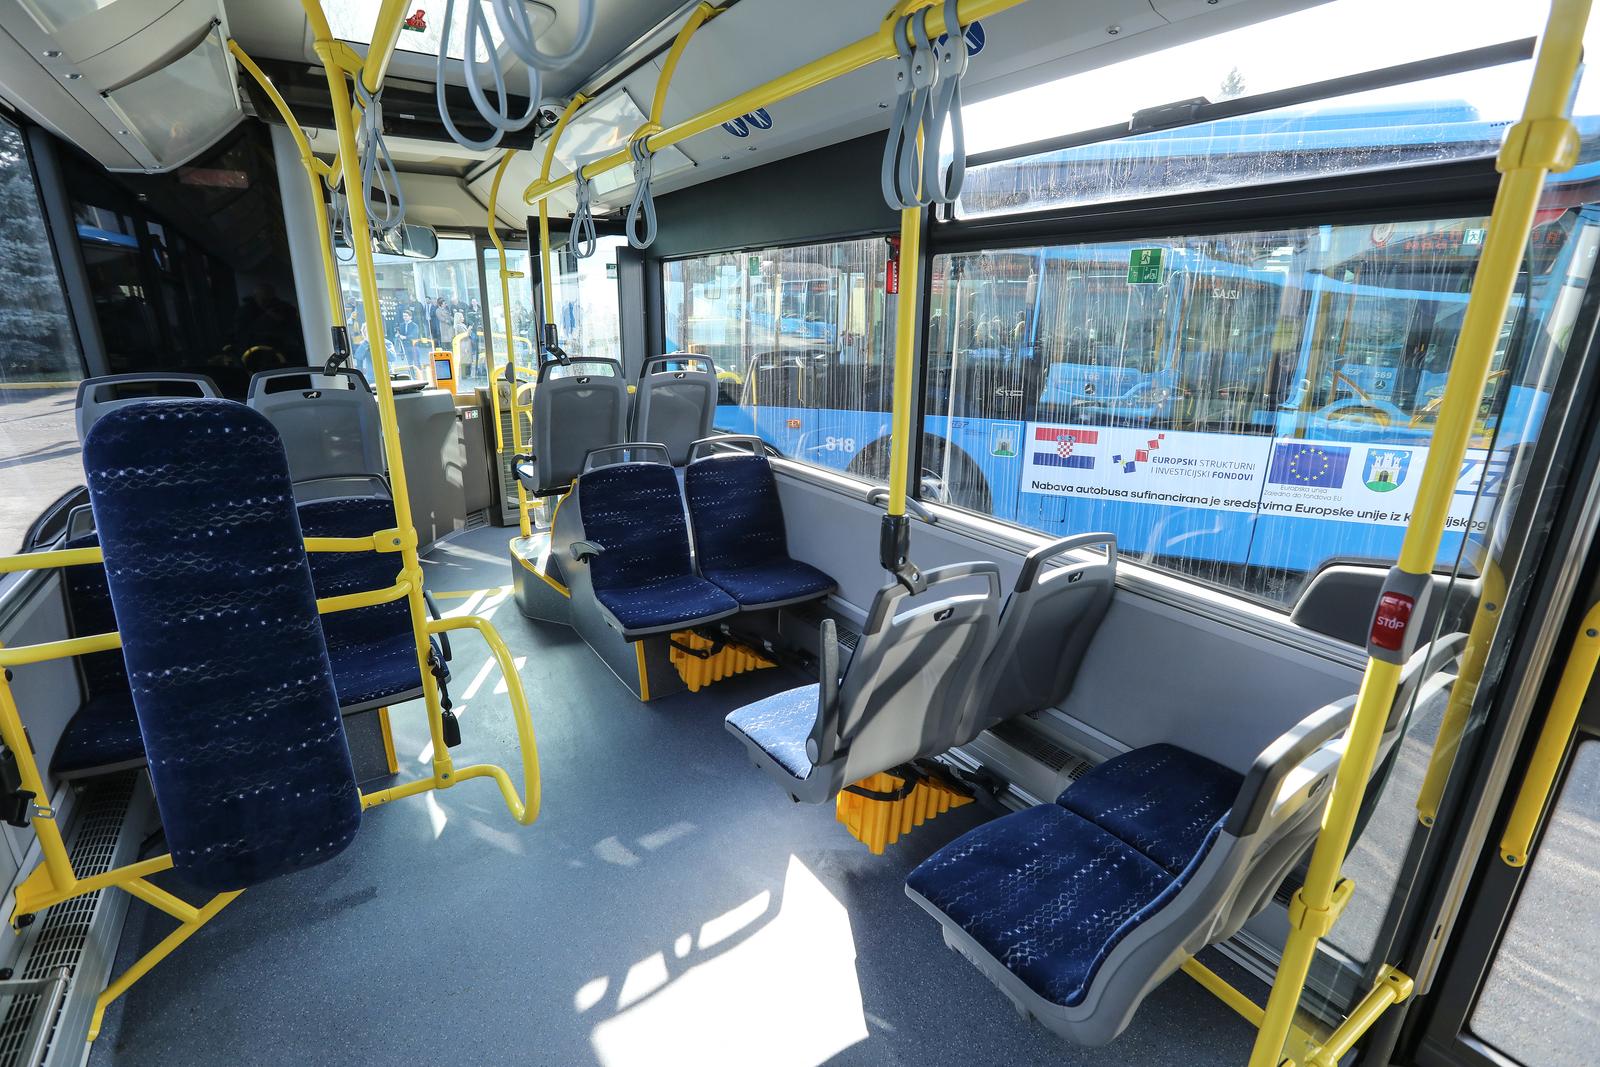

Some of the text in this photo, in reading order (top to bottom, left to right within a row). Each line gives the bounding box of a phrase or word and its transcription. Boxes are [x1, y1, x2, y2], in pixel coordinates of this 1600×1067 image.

[825, 436, 855, 452] 818
[1152, 456, 1256, 471] EUROPSKI STRUKTURNI
[1155, 467, 1211, 479] INVESTICIJSKI
[1211, 471, 1254, 481] FONDOVI
[1031, 480, 1074, 493] Nabava
[1075, 485, 1129, 498] autobusa
[1130, 490, 1209, 505] sufinancirana
[1209, 496, 1221, 507] je
[1223, 499, 1293, 513] sredstvima
[1295, 504, 1354, 518] Europske
[1357, 509, 1388, 521] unije
[1390, 511, 1401, 521] iz
[1376, 616, 1405, 629] STOP
